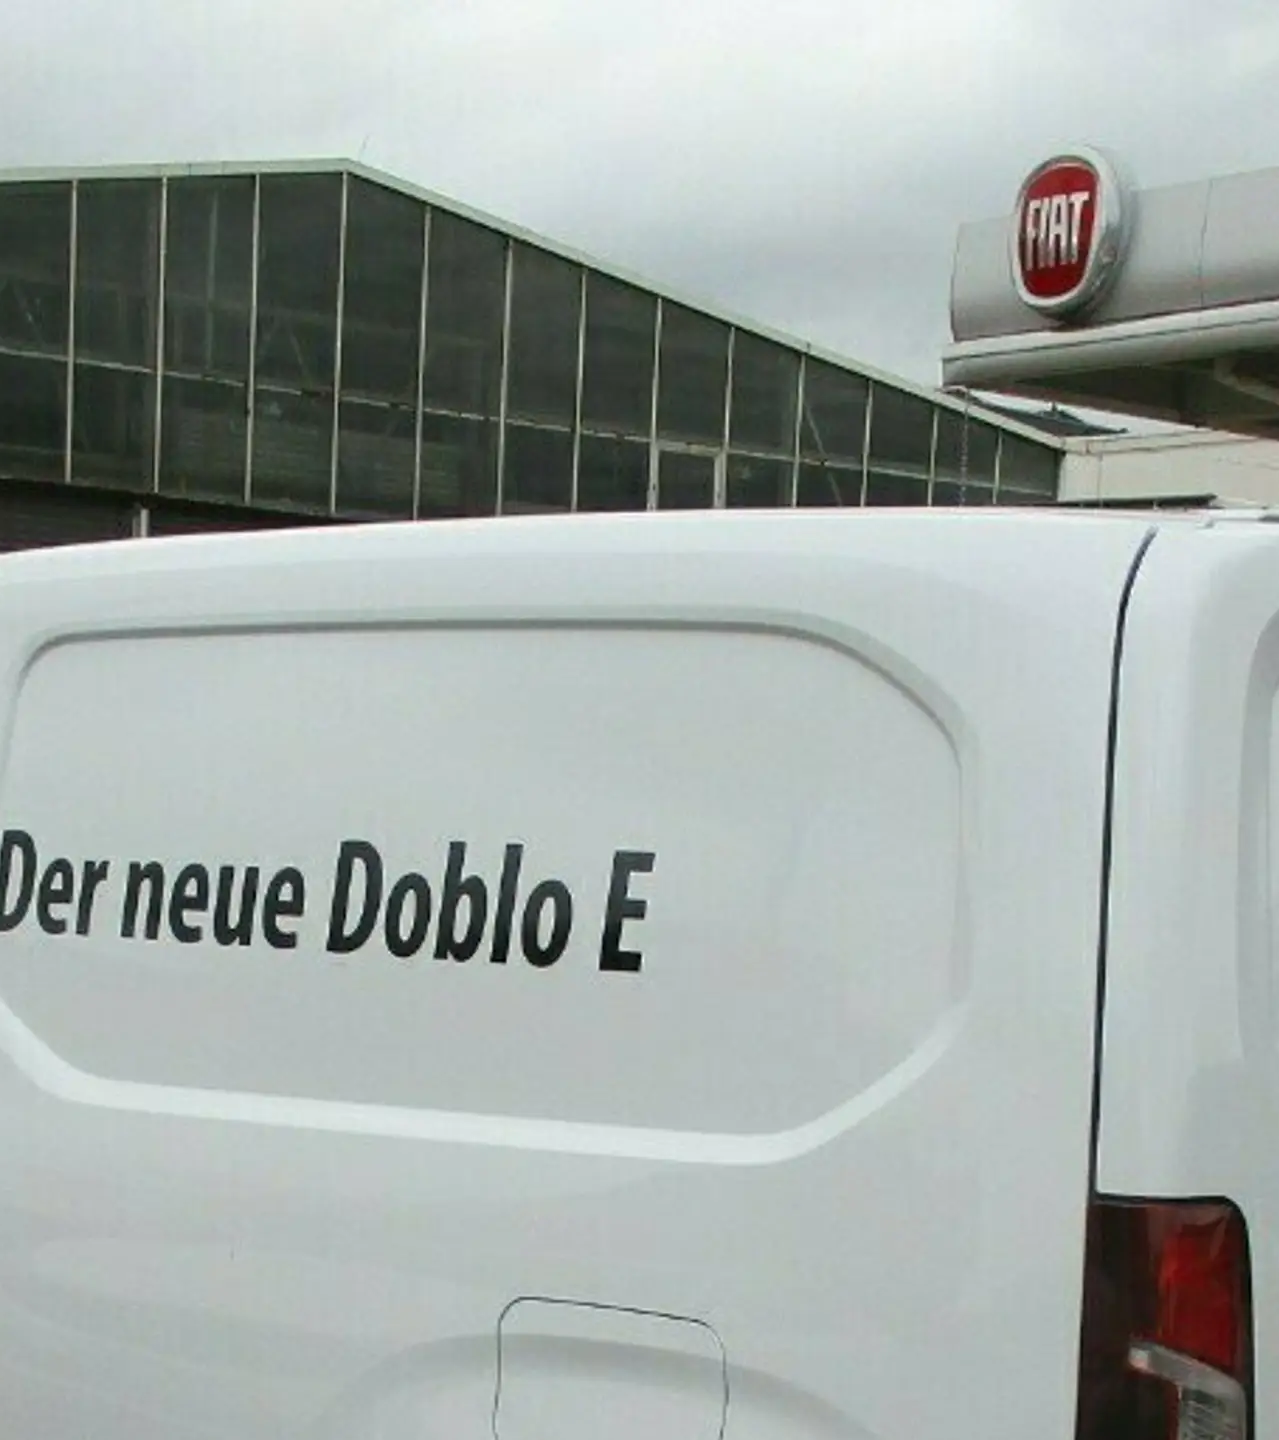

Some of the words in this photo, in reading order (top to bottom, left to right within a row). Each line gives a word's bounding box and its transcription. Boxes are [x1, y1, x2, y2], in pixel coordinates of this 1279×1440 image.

[1025, 191, 1090, 271] FIAT
[120, 859, 306, 950] neue
[325, 839, 573, 969] Doblo
[598, 849, 657, 973] E
